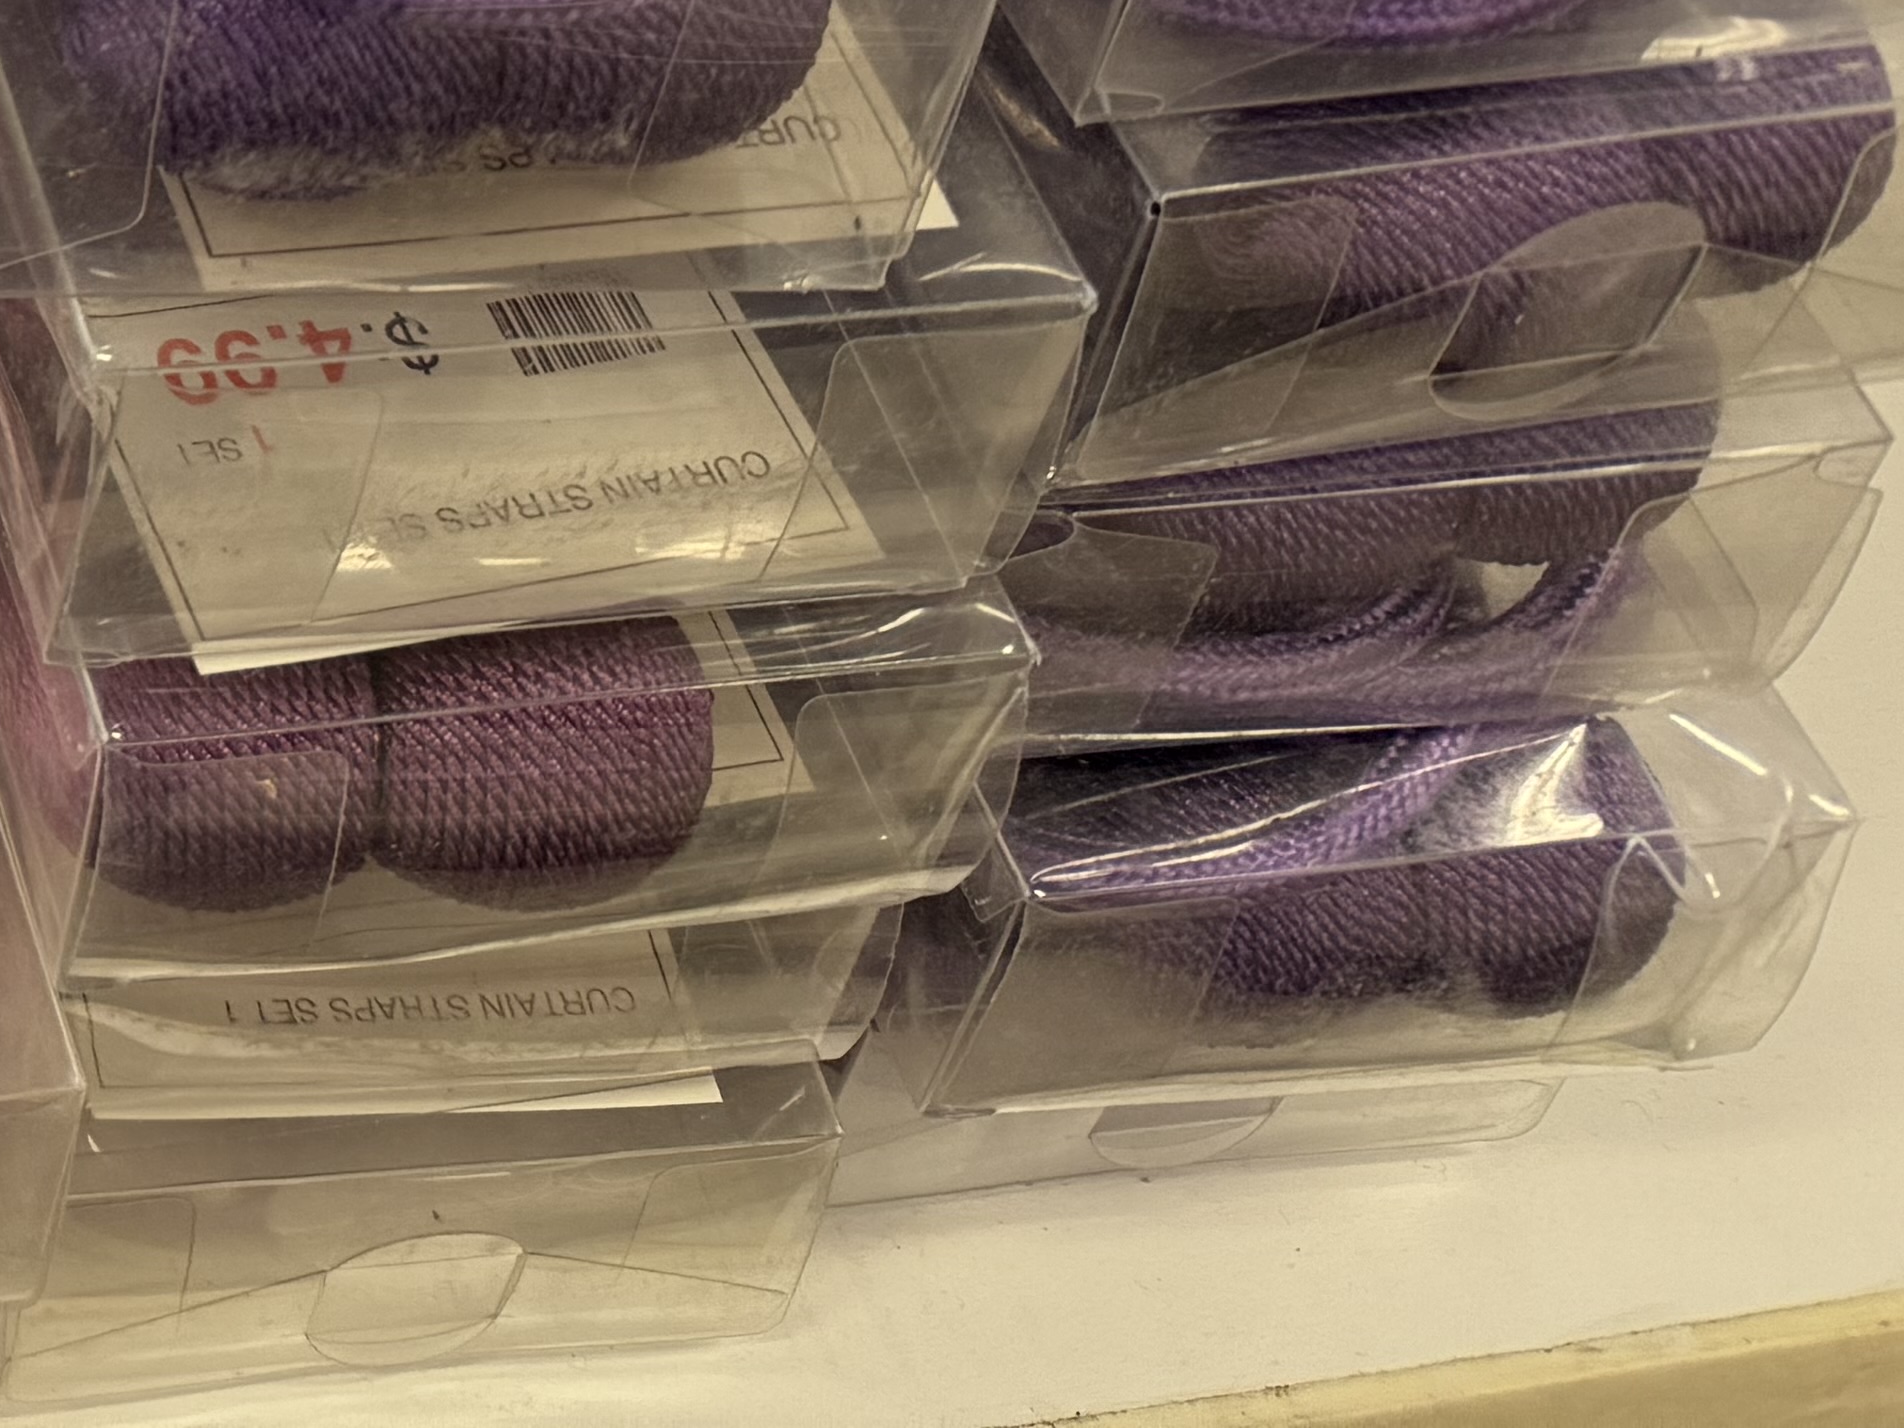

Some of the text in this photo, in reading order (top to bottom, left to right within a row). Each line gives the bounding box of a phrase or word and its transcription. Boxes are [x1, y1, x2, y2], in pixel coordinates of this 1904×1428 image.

[601, 449, 772, 505] CURTAIN
[225, 985, 636, 1026] CURTAIN STRAPS SET 1
